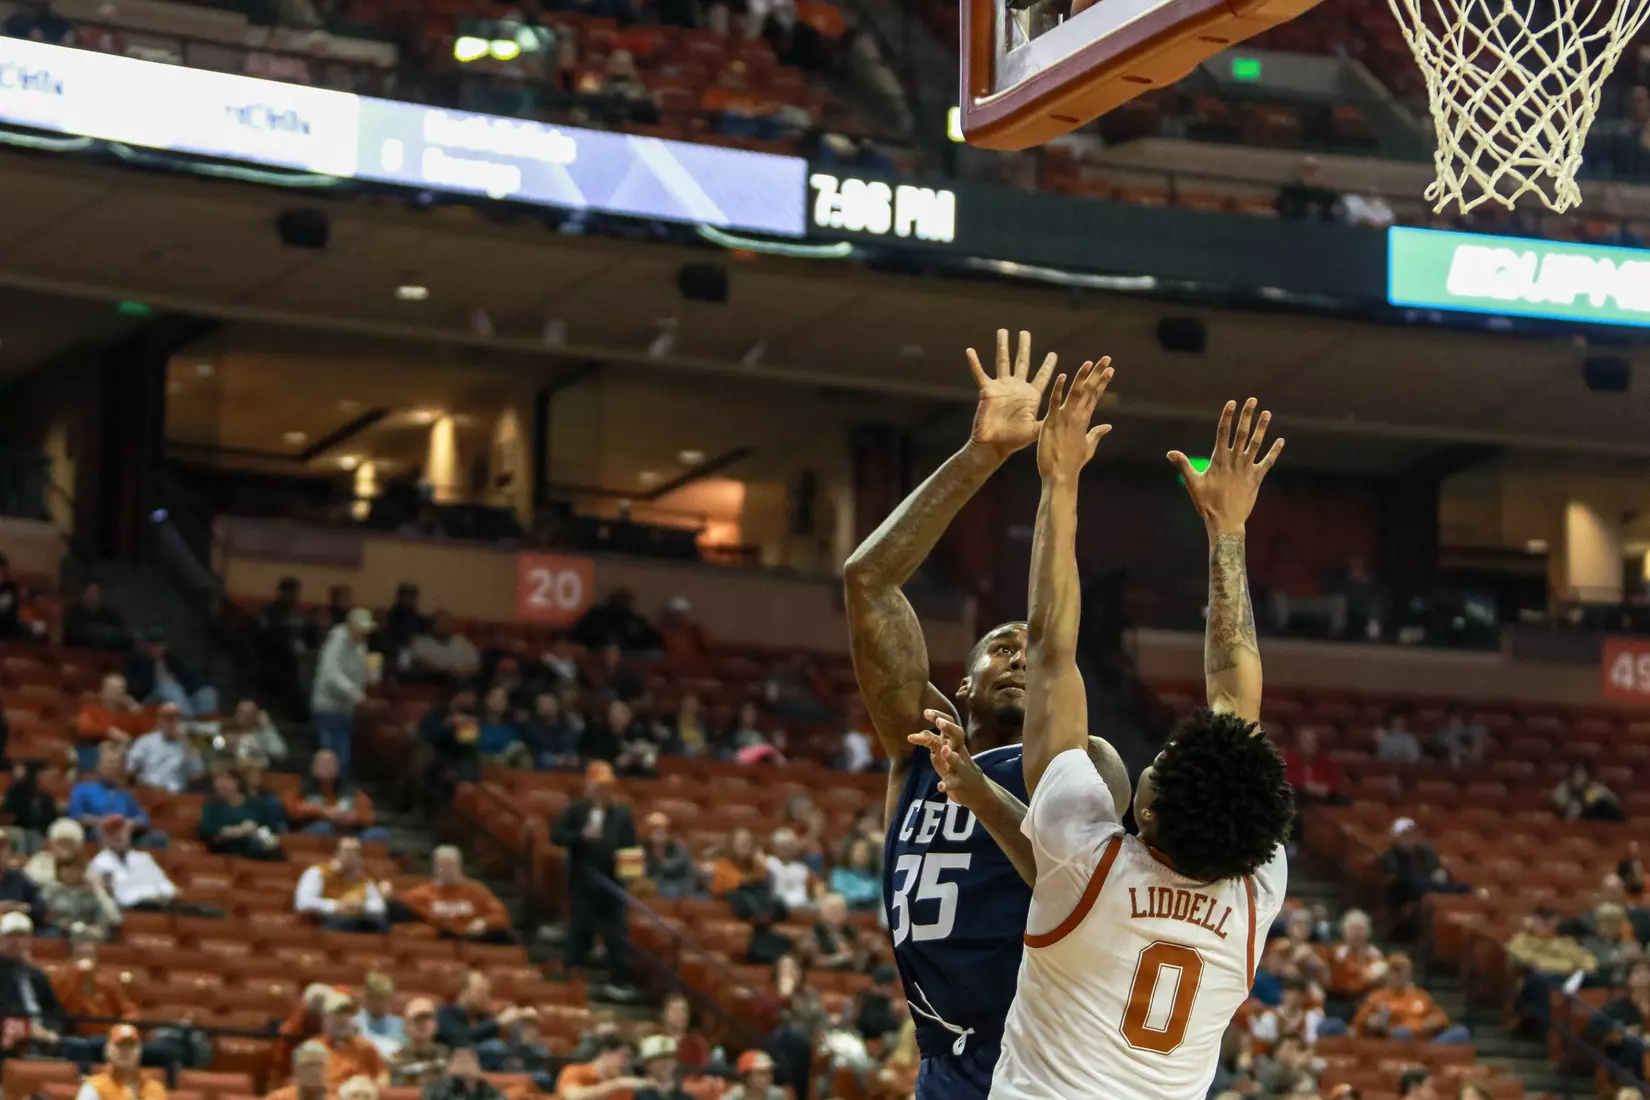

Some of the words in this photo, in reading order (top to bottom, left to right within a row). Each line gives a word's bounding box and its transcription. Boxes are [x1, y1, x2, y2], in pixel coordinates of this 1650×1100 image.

[895, 185, 955, 242] PM
[524, 567, 582, 611] 20
[892, 852, 972, 947] 35
[1129, 887, 1232, 939] LIDDELL
[1119, 940, 1205, 1055] 0
